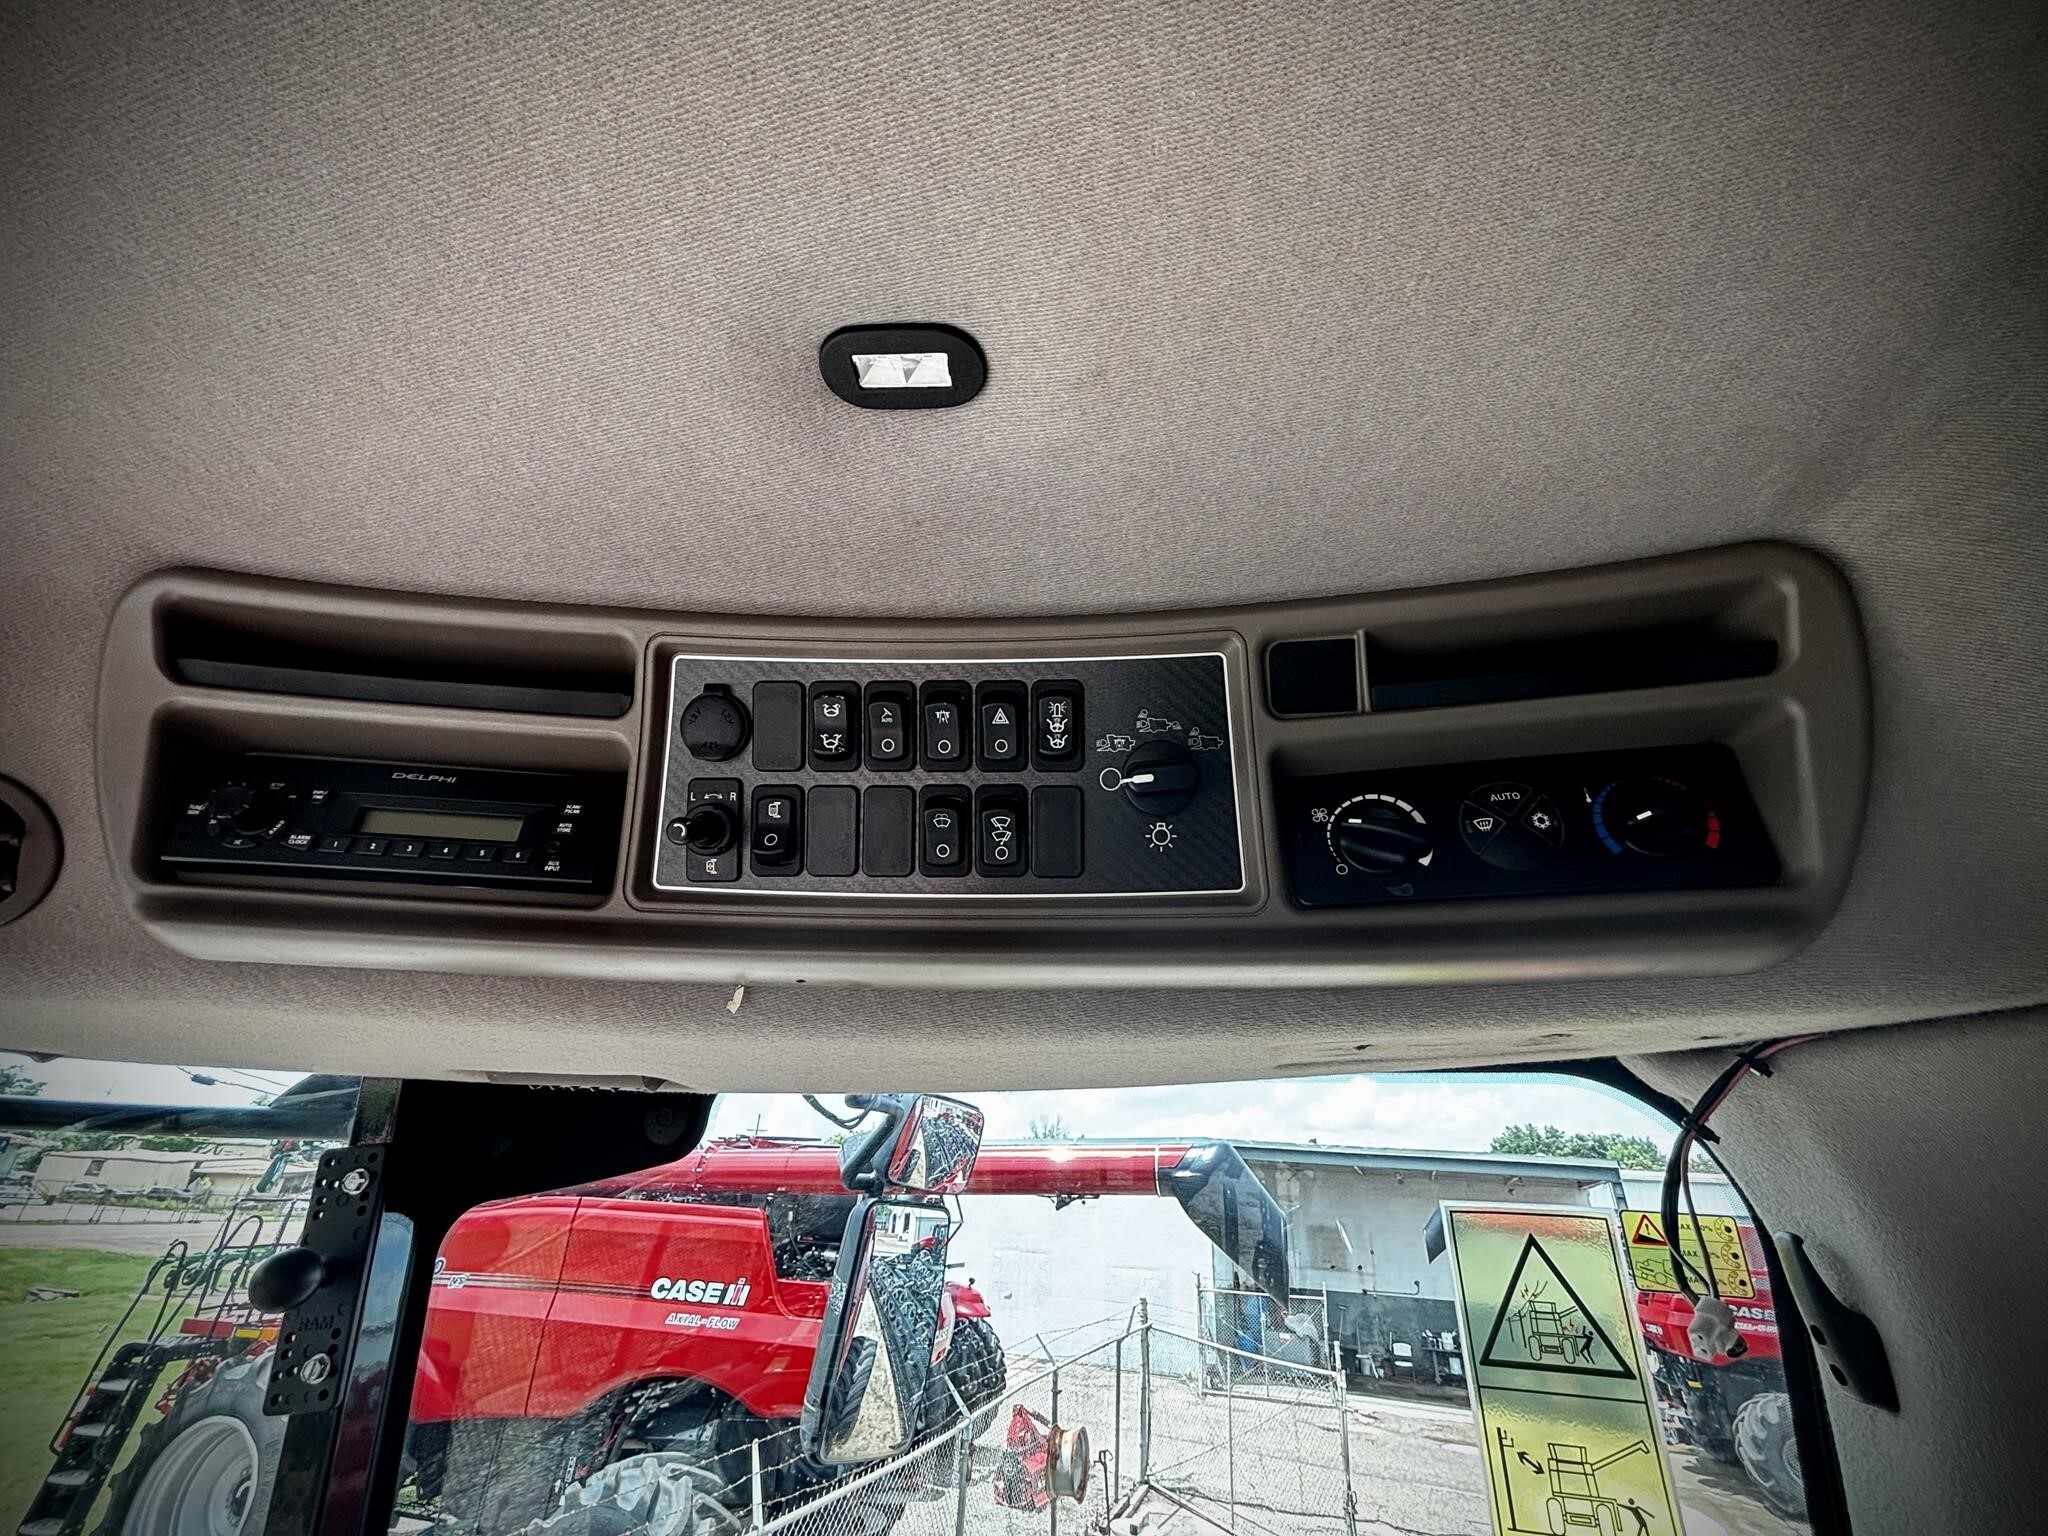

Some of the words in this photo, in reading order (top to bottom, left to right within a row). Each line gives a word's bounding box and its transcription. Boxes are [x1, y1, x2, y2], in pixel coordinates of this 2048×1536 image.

[391, 772, 457, 784] DELPHI
[690, 792, 696, 801] L
[730, 791, 737, 801] R
[1490, 791, 1521, 802] AUTO
[268, 819, 286, 836] BAND
[369, 842, 377, 850] 2
[406, 844, 413, 852] 3
[651, 1277, 724, 1304] CASE
[299, 1314, 334, 1331] RAM
[665, 1312, 740, 1330] AXIAL-FLOW
